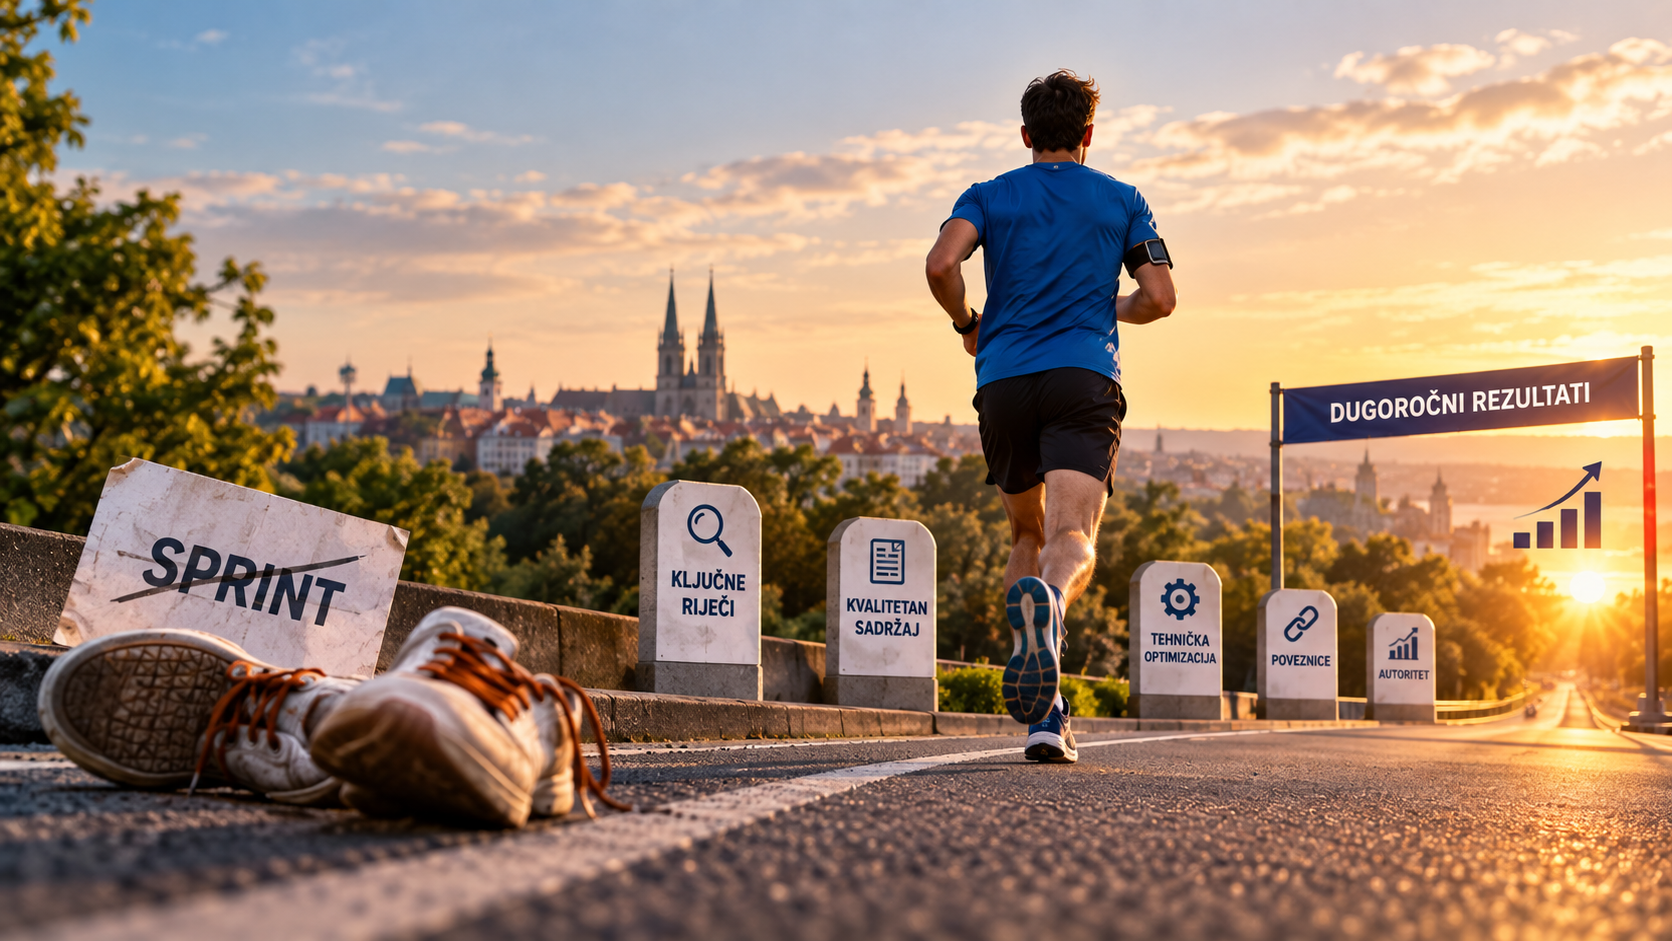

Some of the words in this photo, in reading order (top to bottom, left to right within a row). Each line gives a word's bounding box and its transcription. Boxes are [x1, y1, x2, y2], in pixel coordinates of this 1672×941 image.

[1330, 389, 1464, 423] DUGOROČNI
[1472, 382, 1591, 412] REZULTATI
[142, 537, 346, 627] SPRINT
[671, 568, 746, 591] KLJUČNE
[682, 595, 735, 617] RIJEČI
[846, 598, 928, 615] KVALITETAN
[855, 618, 920, 637] SADRŽAJ
[1151, 631, 1210, 647] TEHNIČKA
[1144, 651, 1217, 664] OPTIMIZACIJA
[1271, 654, 1331, 667] POVEZNICE
[1378, 669, 1430, 680] AUTORITET
